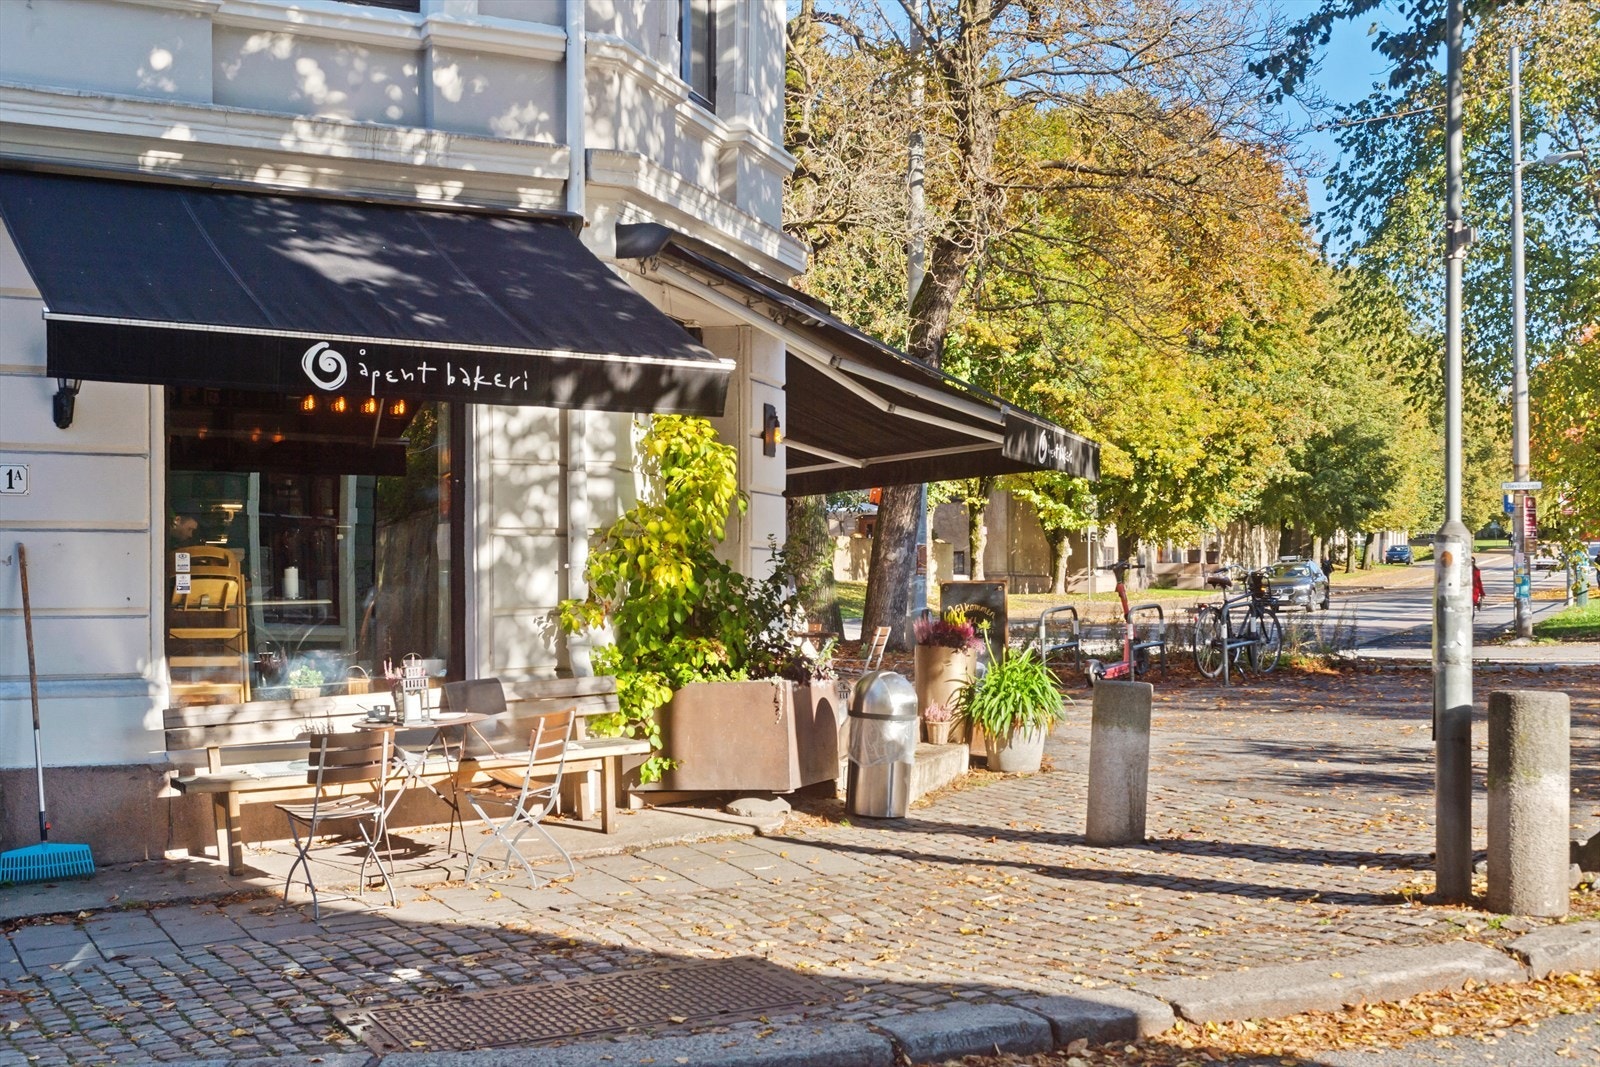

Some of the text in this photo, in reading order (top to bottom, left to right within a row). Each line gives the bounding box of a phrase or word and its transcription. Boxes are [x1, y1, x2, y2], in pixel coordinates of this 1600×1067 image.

[358, 348, 529, 396] åpent bakeri
[6, 468, 23, 490] 1A
